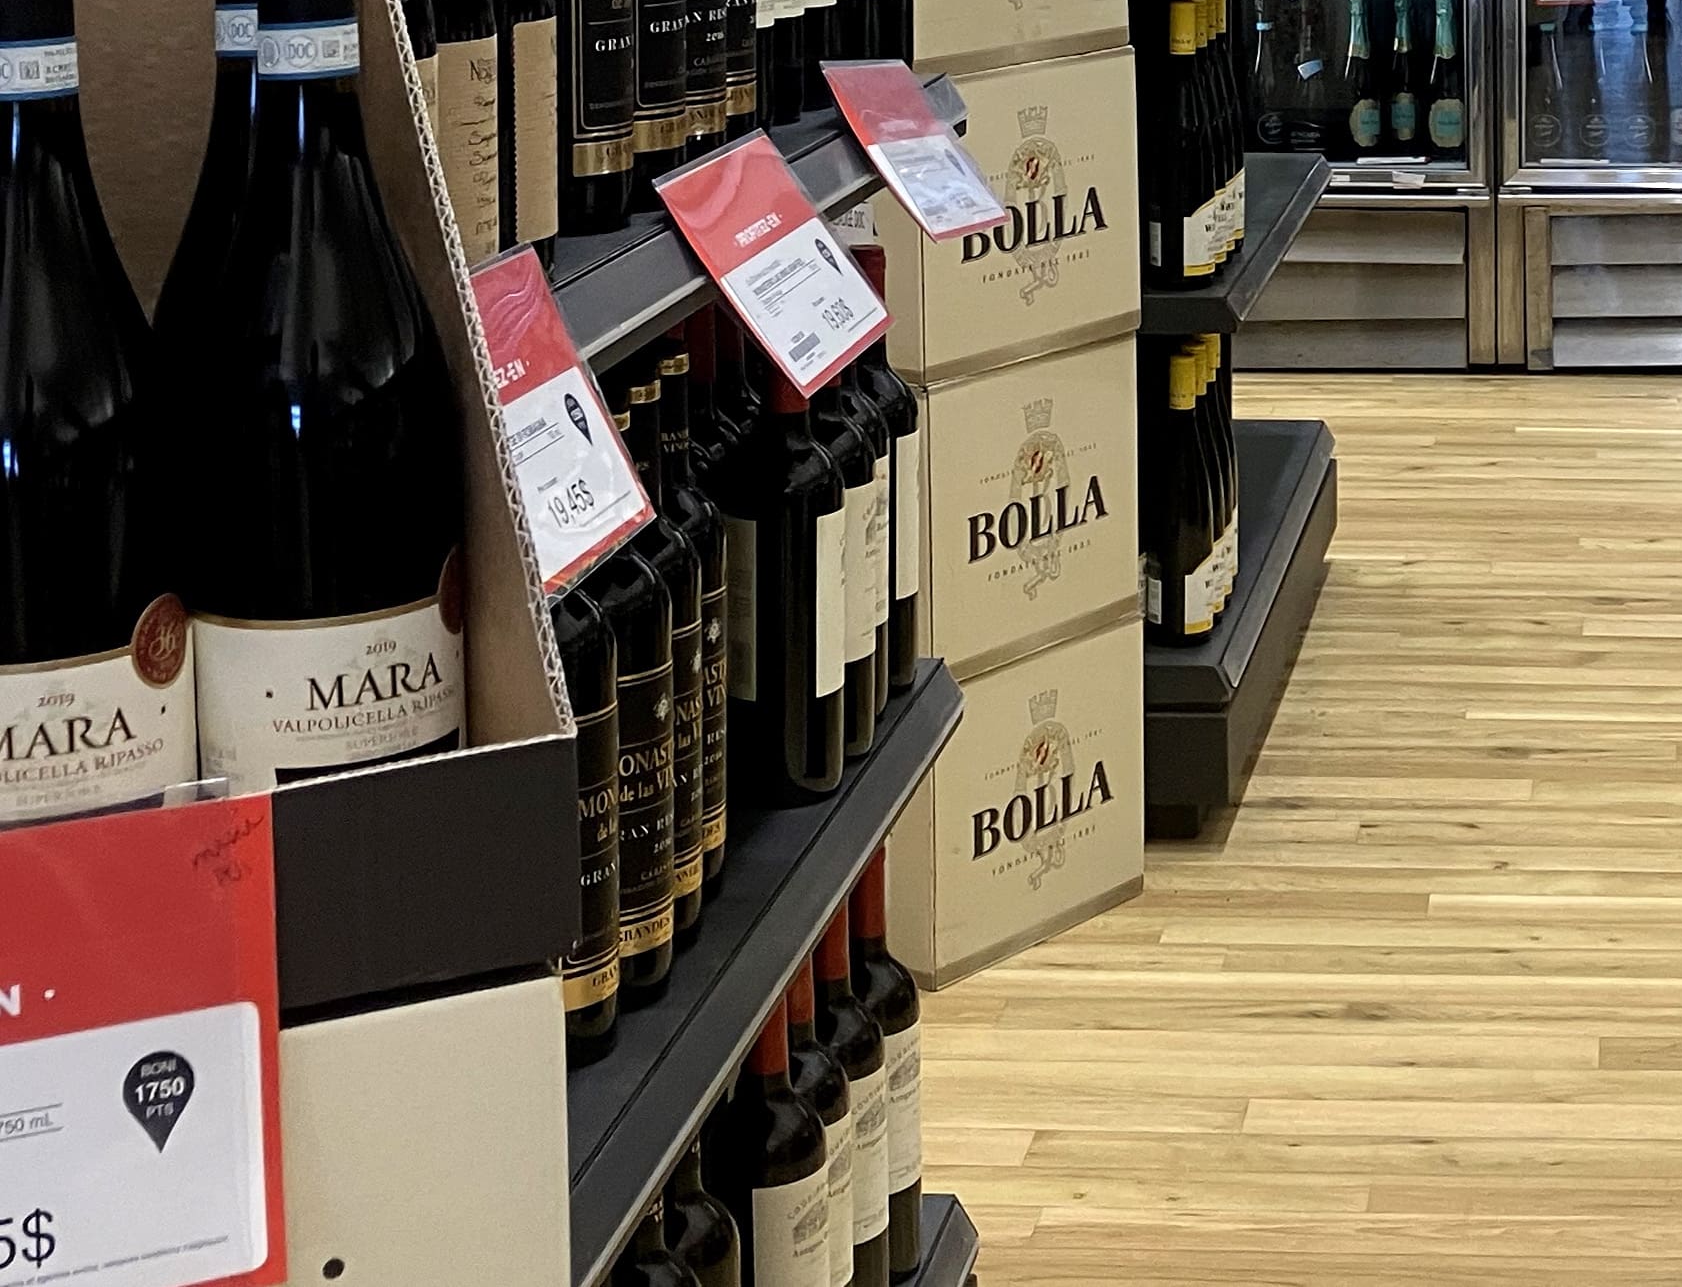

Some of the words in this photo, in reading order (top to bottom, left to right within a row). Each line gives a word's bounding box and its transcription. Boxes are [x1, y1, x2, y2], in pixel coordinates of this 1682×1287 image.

[961, 186, 1108, 264] BOLLA
[547, 478, 596, 530] 19,45$
[967, 474, 1109, 564] BOLLA
[365, 639, 397, 656] 2019
[308, 652, 443, 713] MARA
[38, 692, 75, 708] 2019
[272, 703, 408, 735] VALPOLICELLA
[95, 737, 164, 771] RIPASSO
[972, 760, 1115, 862] BOLLA
[133, 1079, 185, 1105] 1750
[28, 1115, 53, 1131] mL
